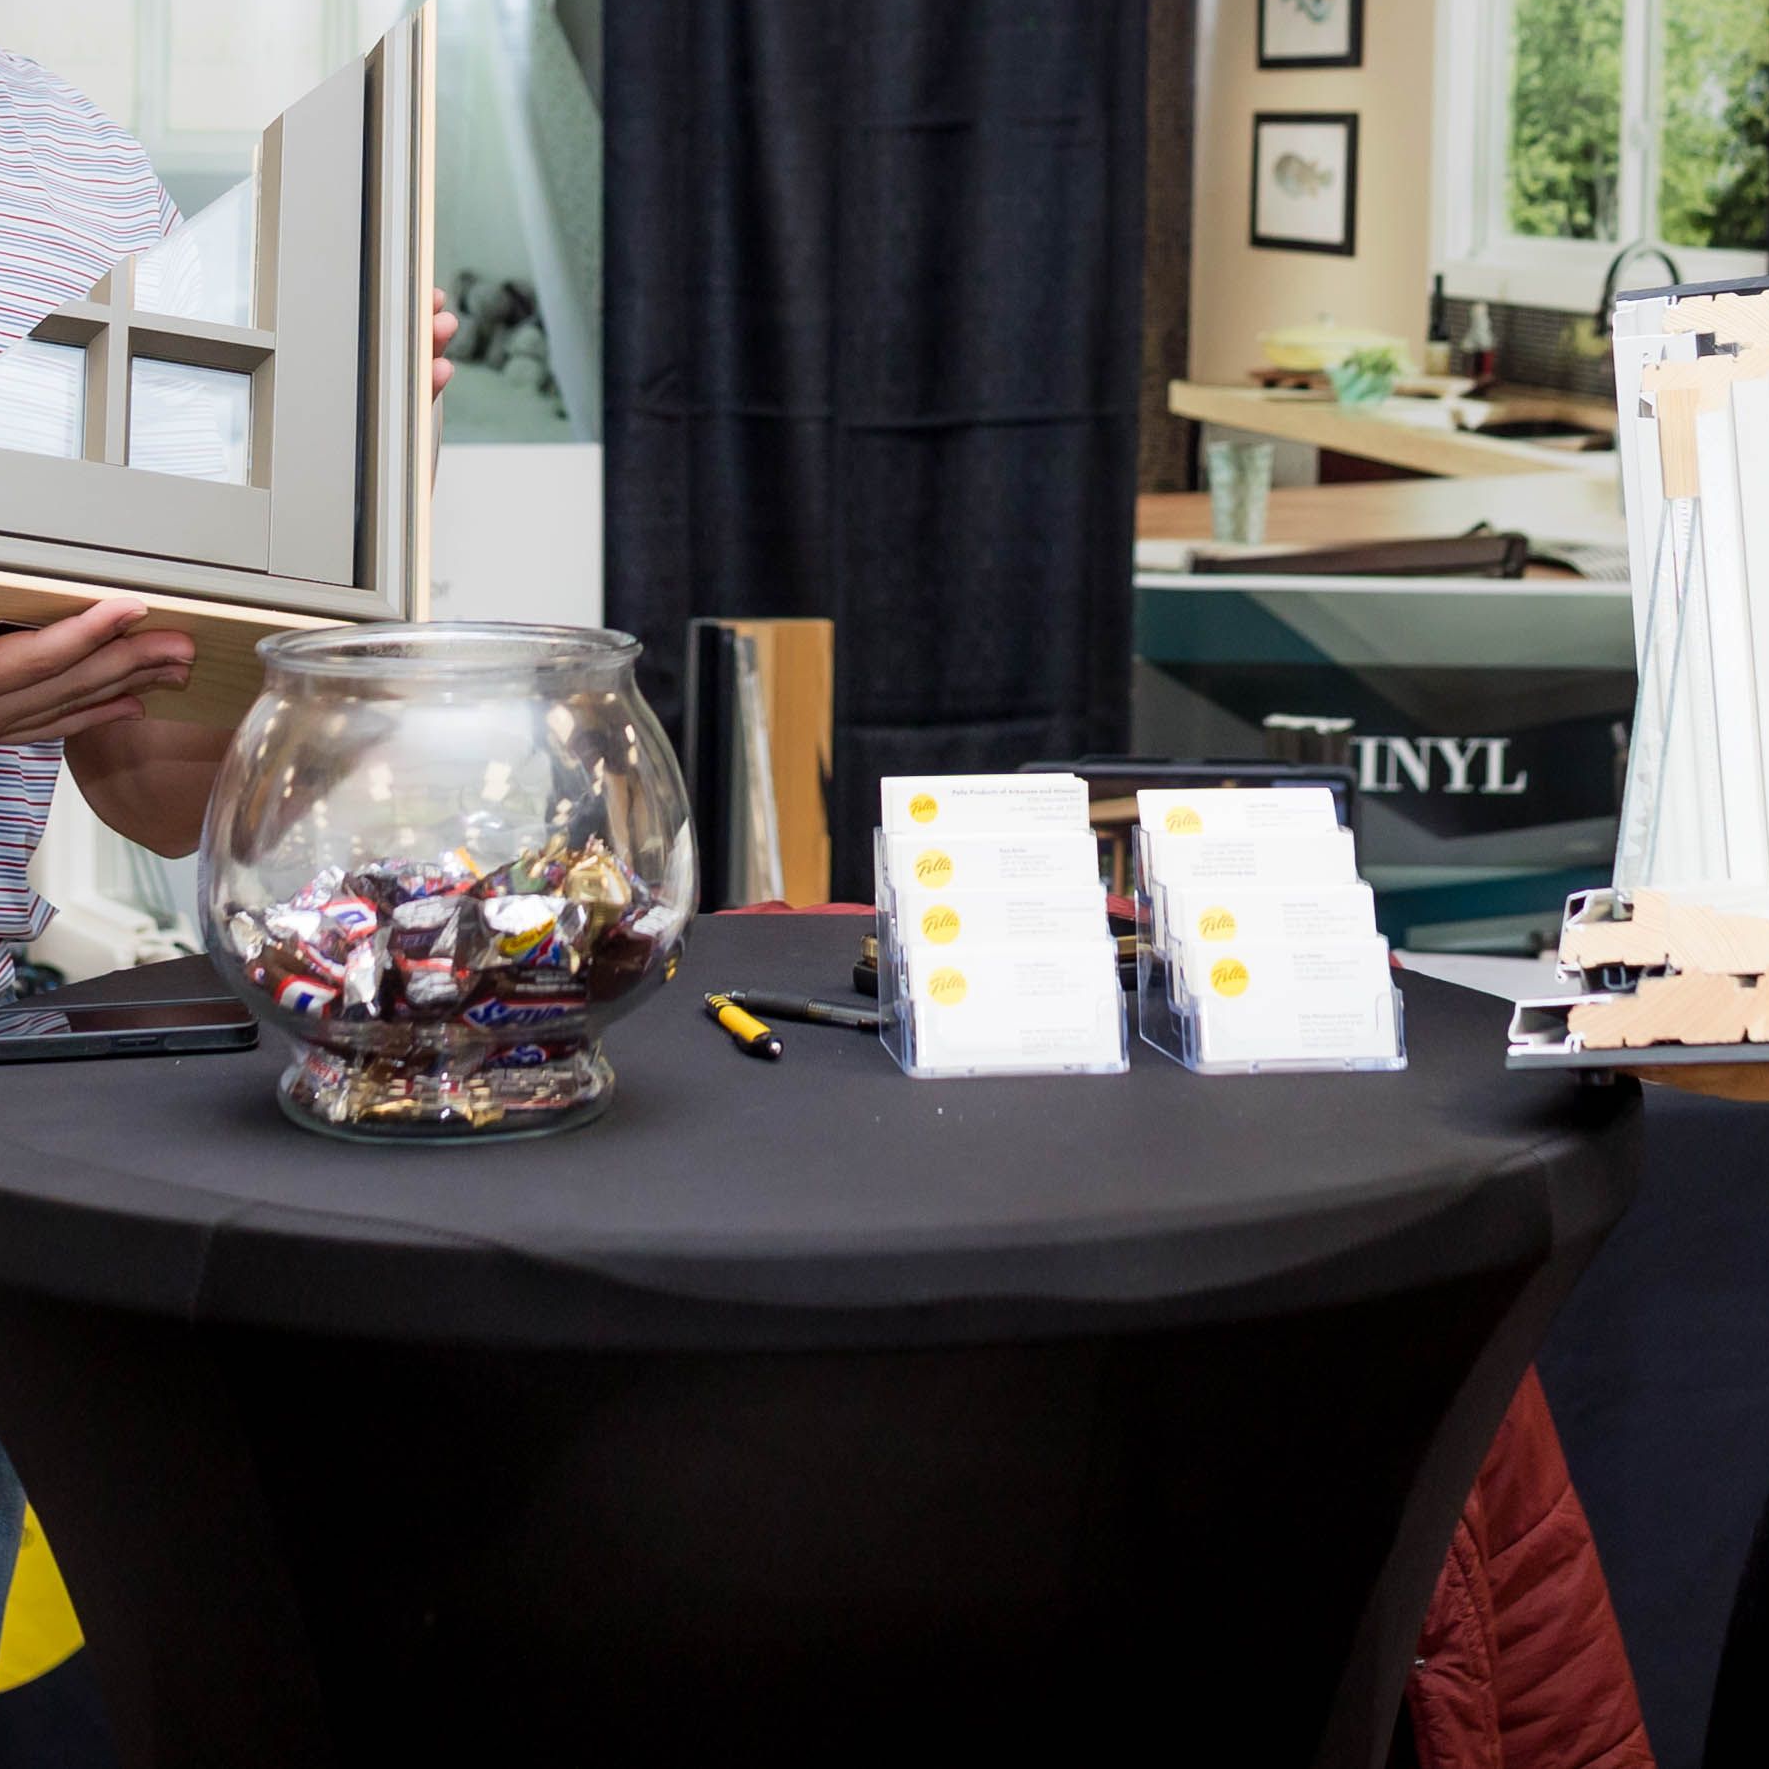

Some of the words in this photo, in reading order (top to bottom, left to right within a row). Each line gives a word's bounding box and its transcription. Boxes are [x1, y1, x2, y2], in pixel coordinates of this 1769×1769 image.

[1349, 735, 1529, 794] INYL
[916, 858, 952, 879] Pella
[923, 911, 959, 934] Pella
[1199, 914, 1235, 935] Pella
[1212, 967, 1247, 988] Pella
